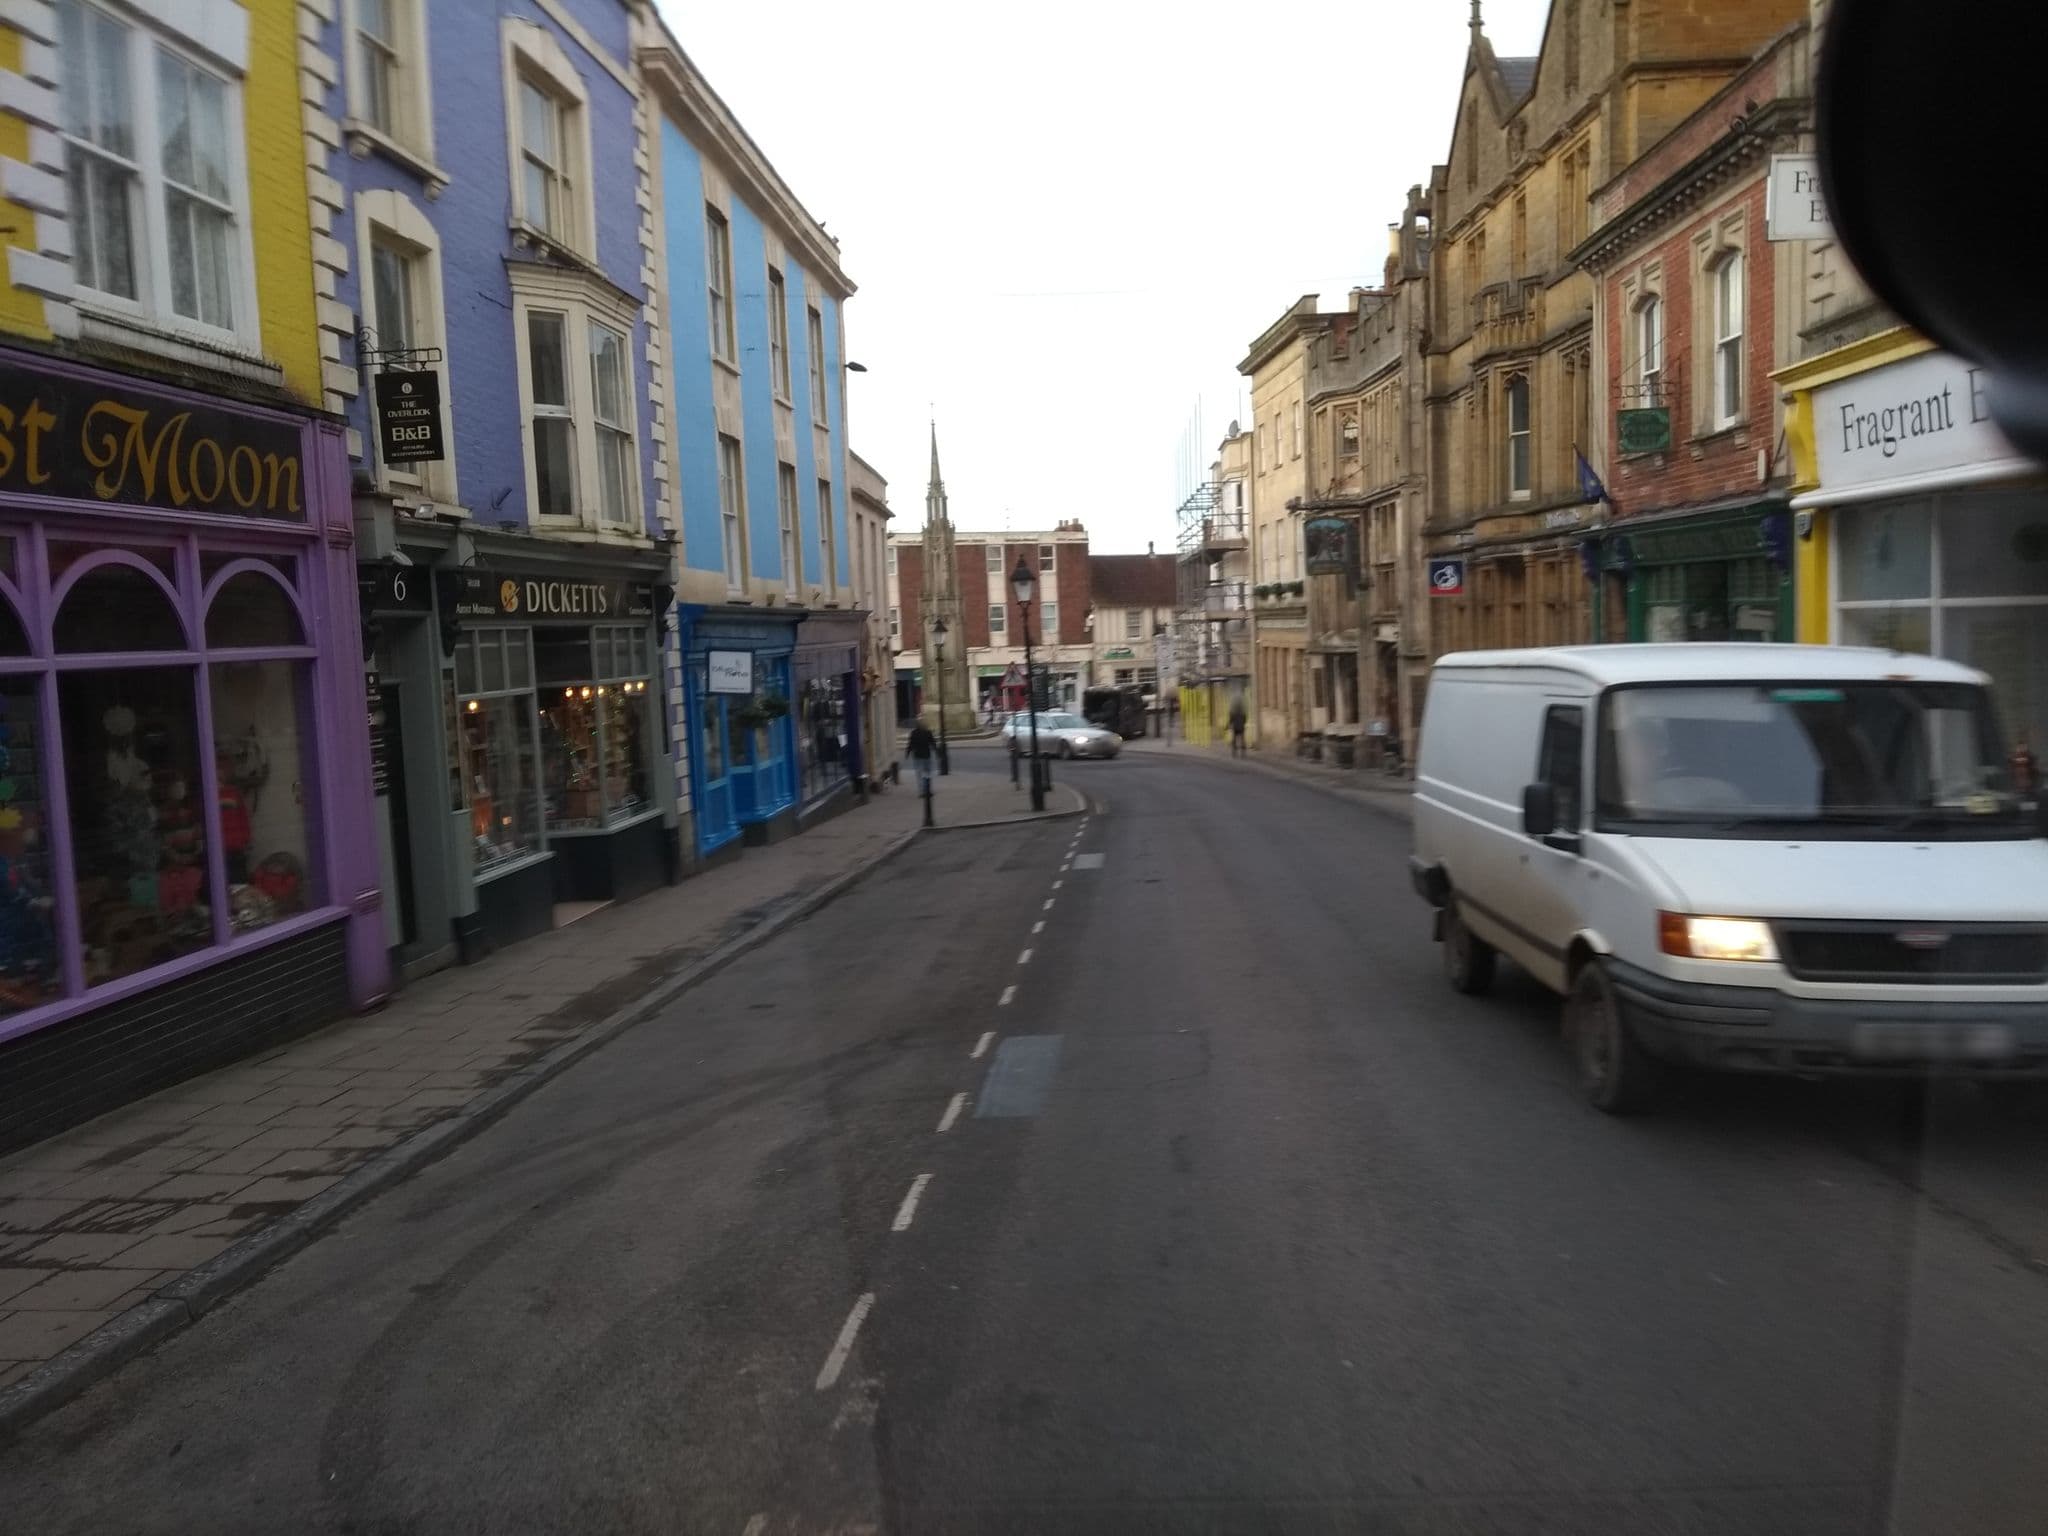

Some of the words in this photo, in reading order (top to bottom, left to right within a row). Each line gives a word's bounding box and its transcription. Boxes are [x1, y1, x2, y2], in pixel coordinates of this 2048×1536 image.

[387, 408, 431, 418] OVERLOOK
[401, 401, 417, 409] THE
[1840, 381, 1954, 458] Fragrant
[392, 425, 431, 441] B&B
[81, 400, 300, 513] Moon
[394, 571, 406, 601] 6
[525, 581, 607, 614] DICKETTS
